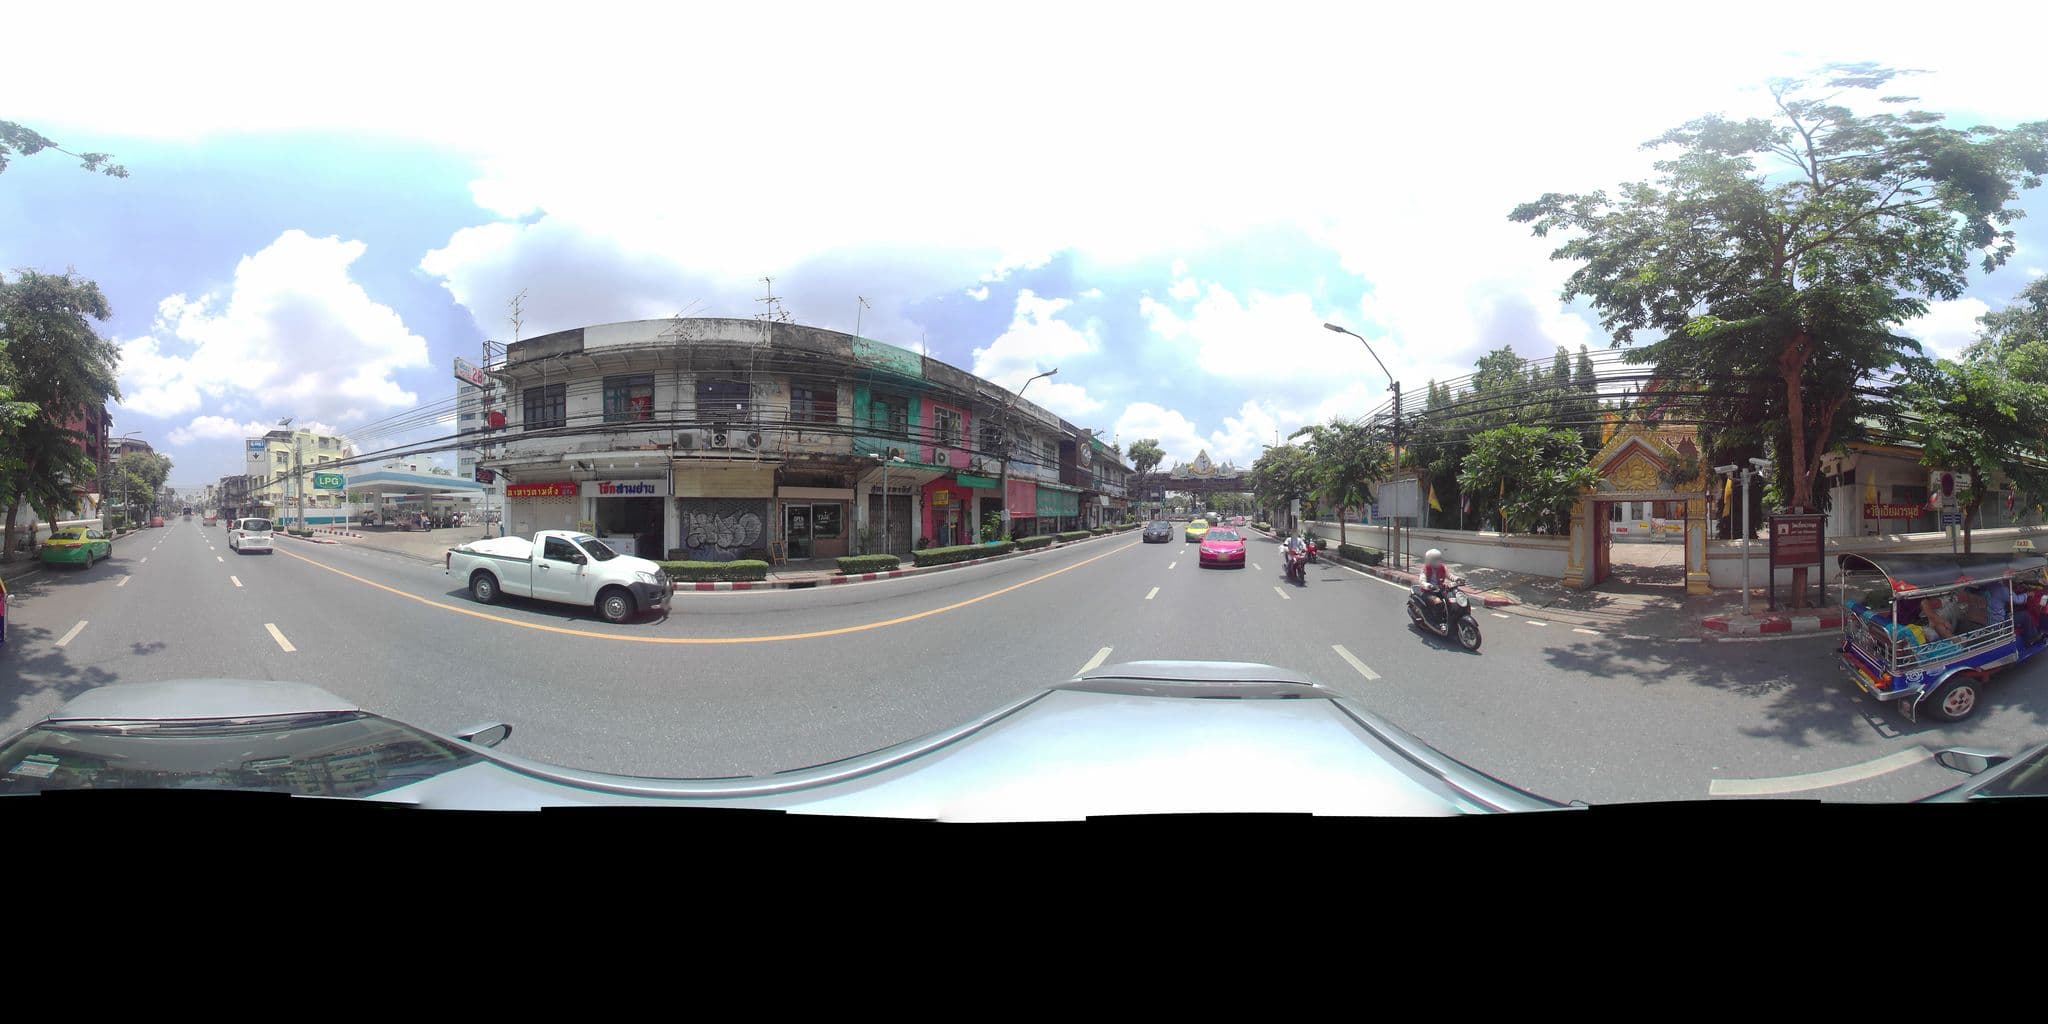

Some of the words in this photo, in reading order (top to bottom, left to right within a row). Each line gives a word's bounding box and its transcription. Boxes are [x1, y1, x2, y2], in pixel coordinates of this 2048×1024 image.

[319, 477, 339, 485] LPG
[598, 481, 655, 494] โจ๊กสามย่าน
